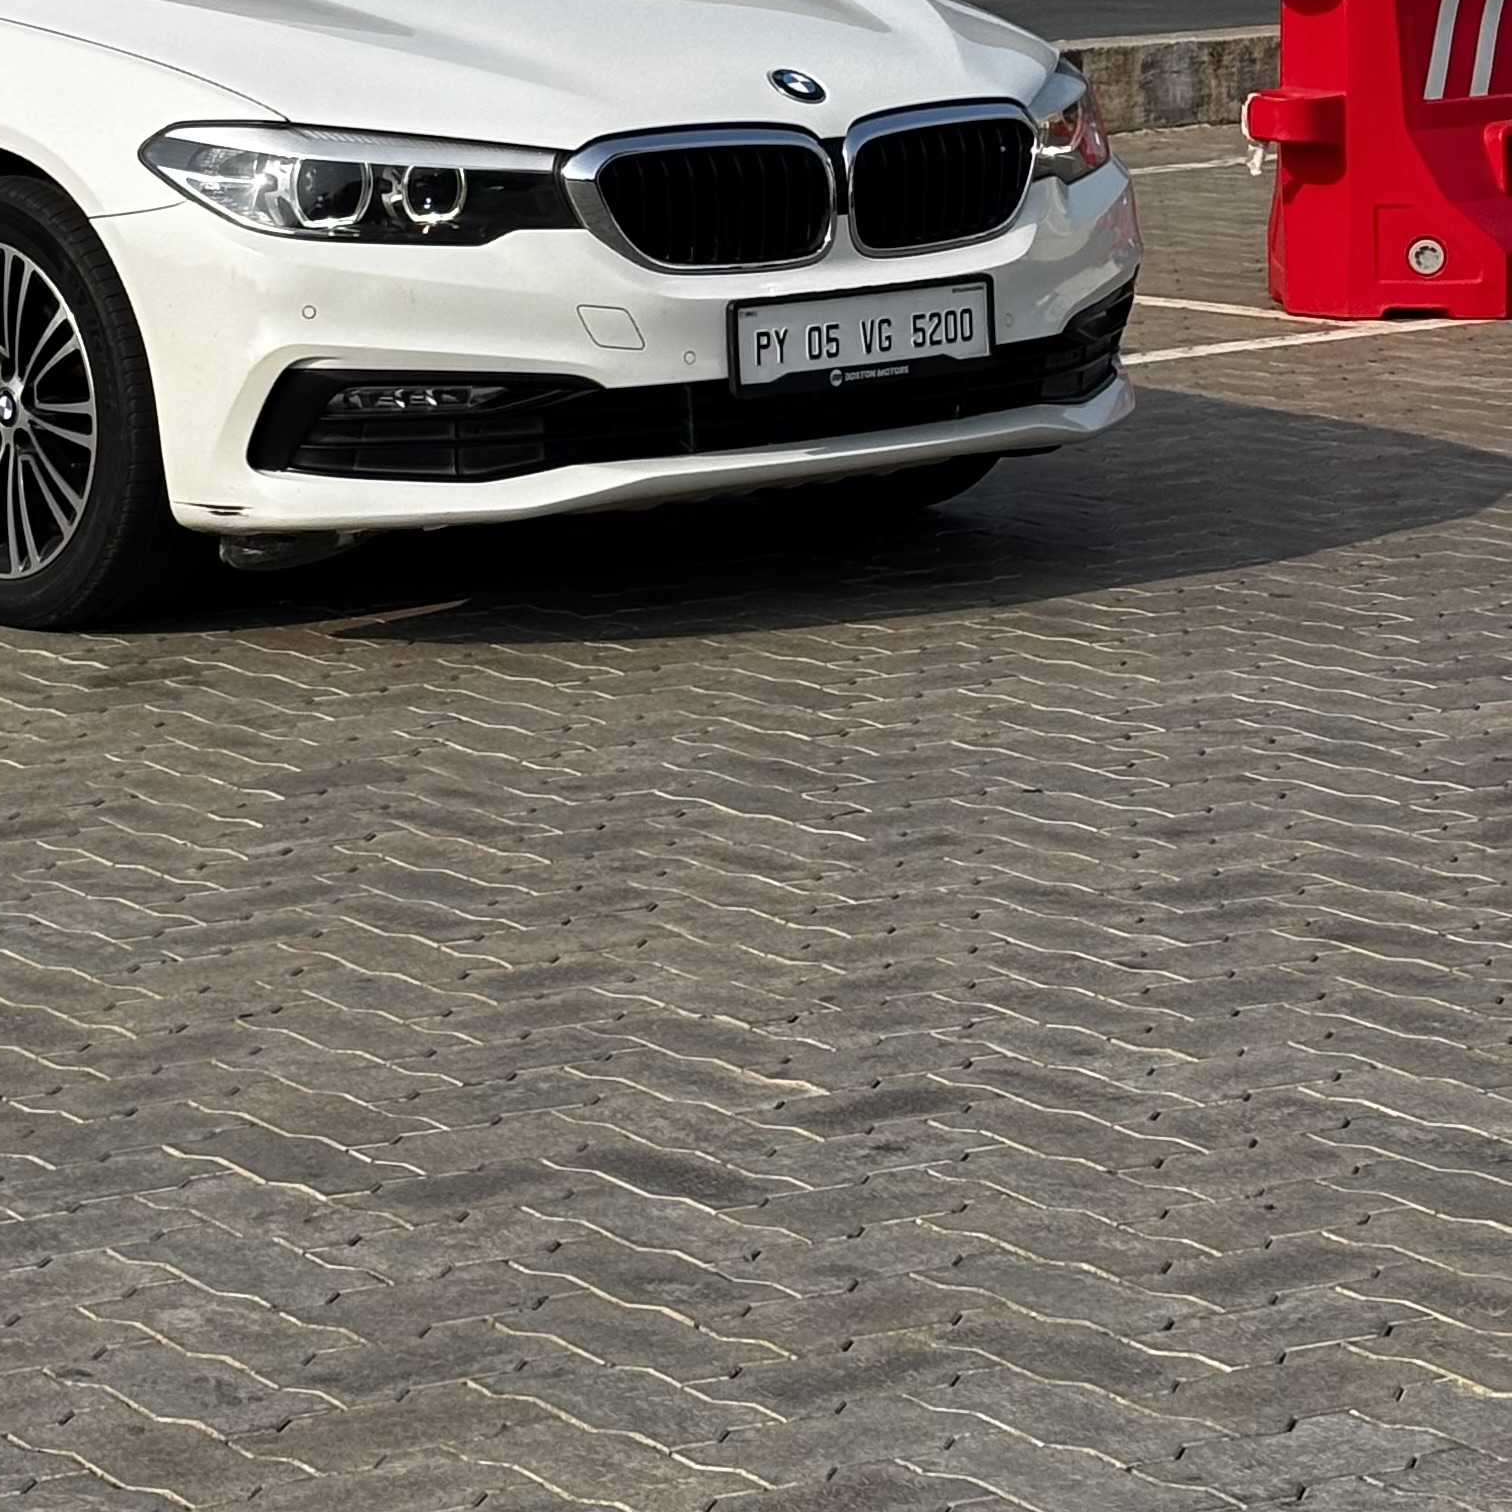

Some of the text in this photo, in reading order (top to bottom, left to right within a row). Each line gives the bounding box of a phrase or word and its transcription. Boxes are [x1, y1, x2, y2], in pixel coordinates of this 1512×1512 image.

[755, 308, 974, 366] PY 05 VG 5200
